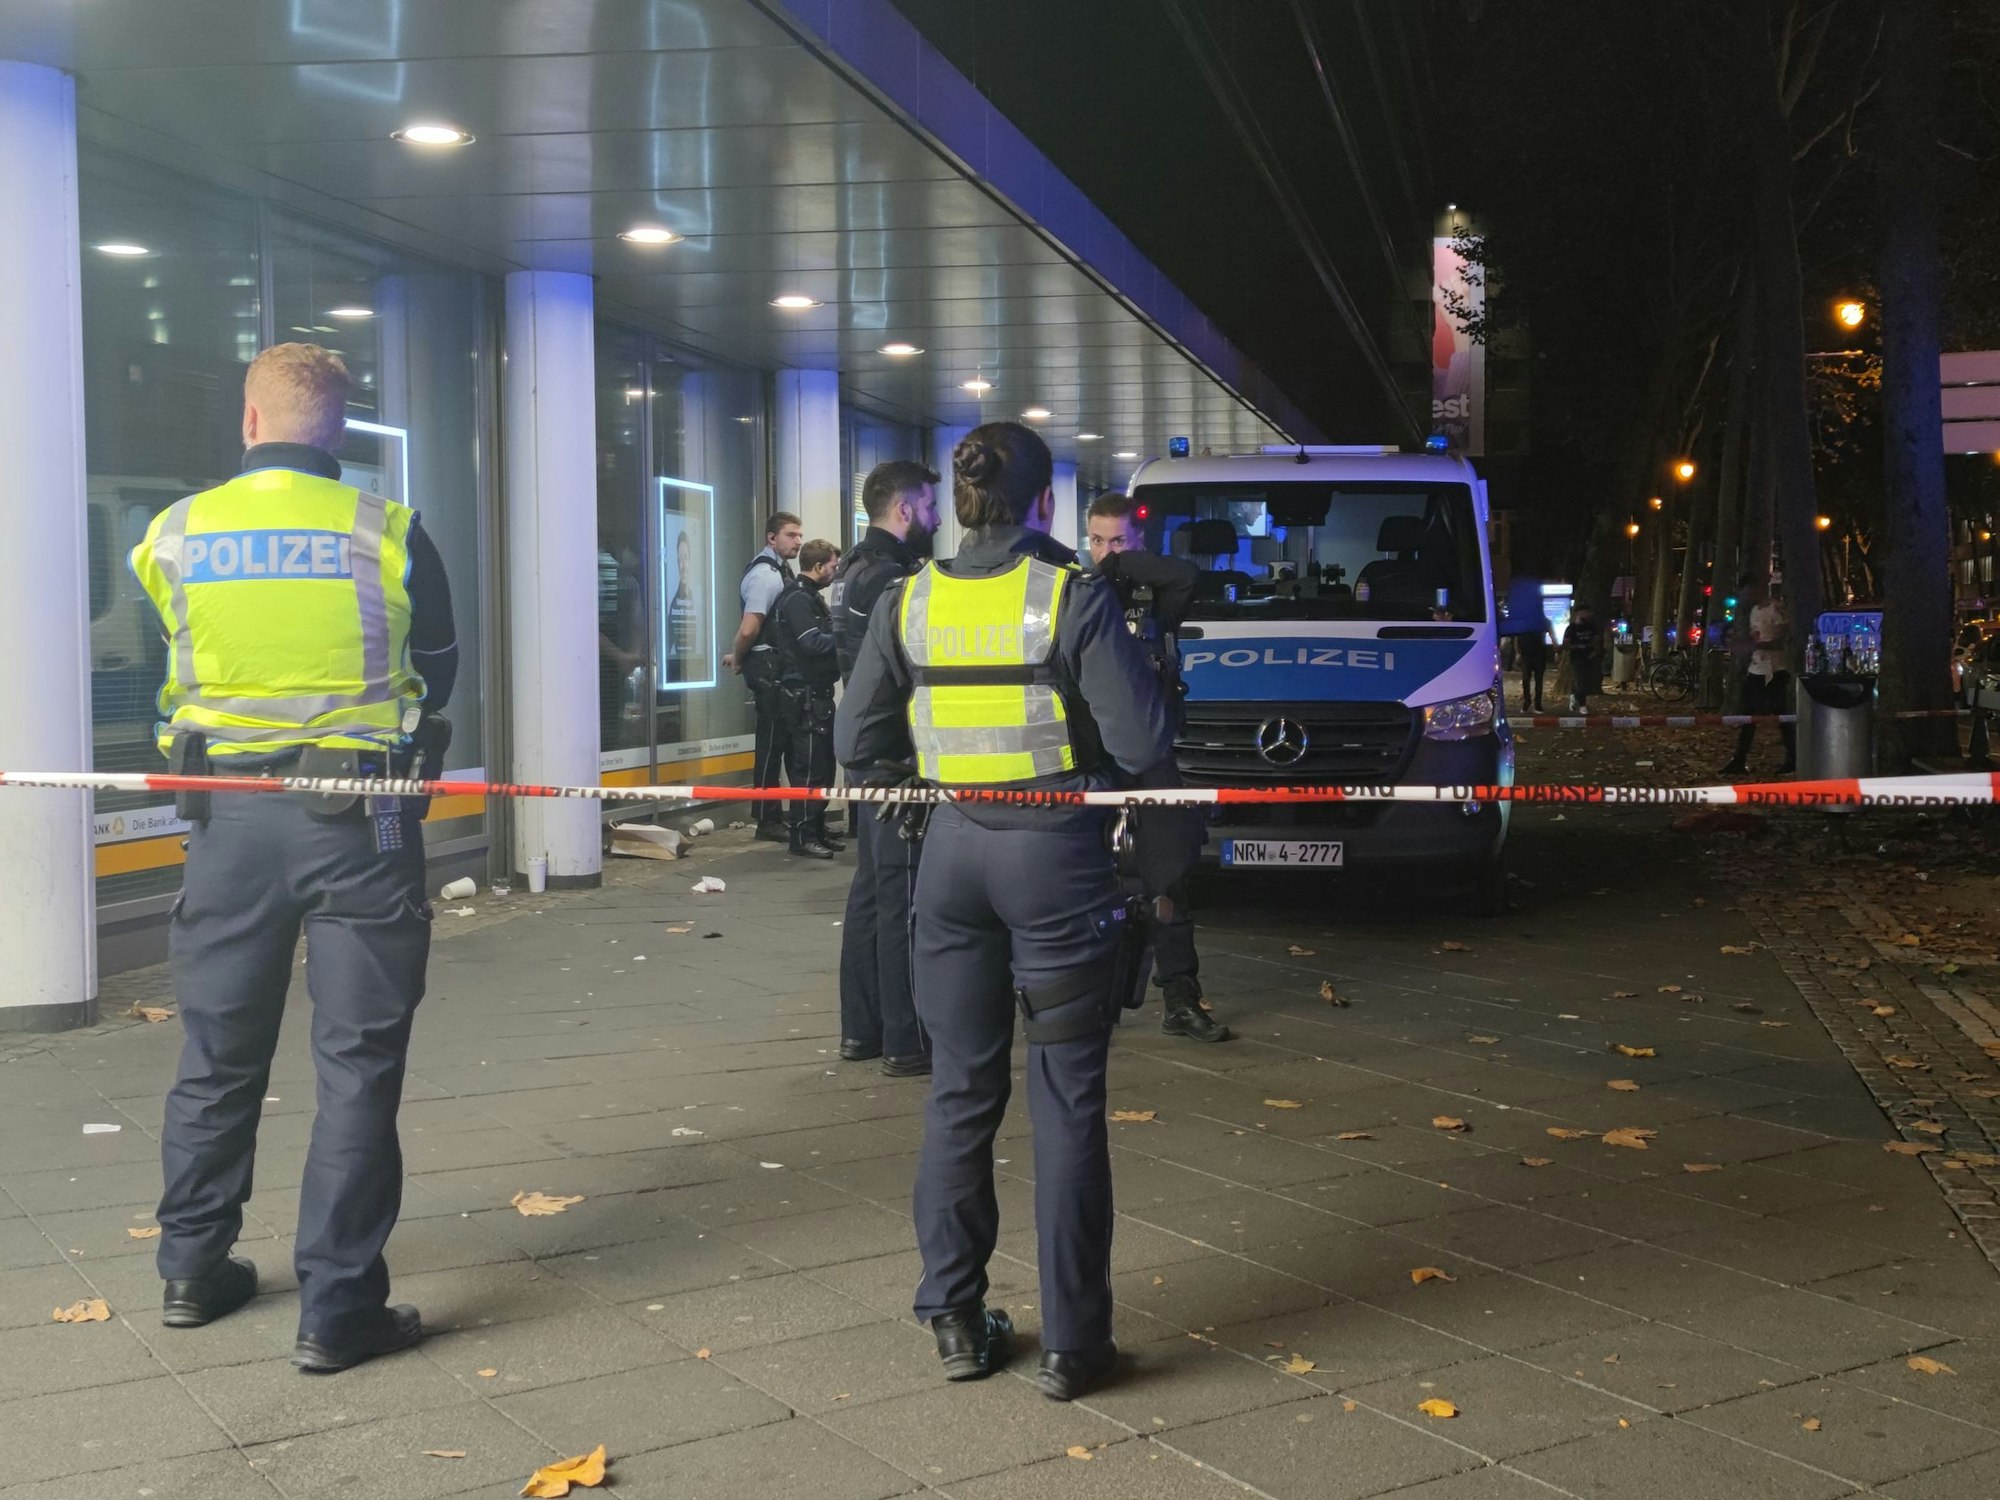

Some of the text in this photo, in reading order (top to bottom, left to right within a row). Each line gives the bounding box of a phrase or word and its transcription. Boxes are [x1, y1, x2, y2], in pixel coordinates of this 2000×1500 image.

[182, 535, 353, 578] POLIZEI
[929, 624, 1024, 659] POLIZEI
[1183, 648, 1395, 672] POLIZEI
[132, 819, 146, 831] Die
[148, 817, 168, 829] Bank
[1234, 843, 1341, 863] NRW 4-2777
